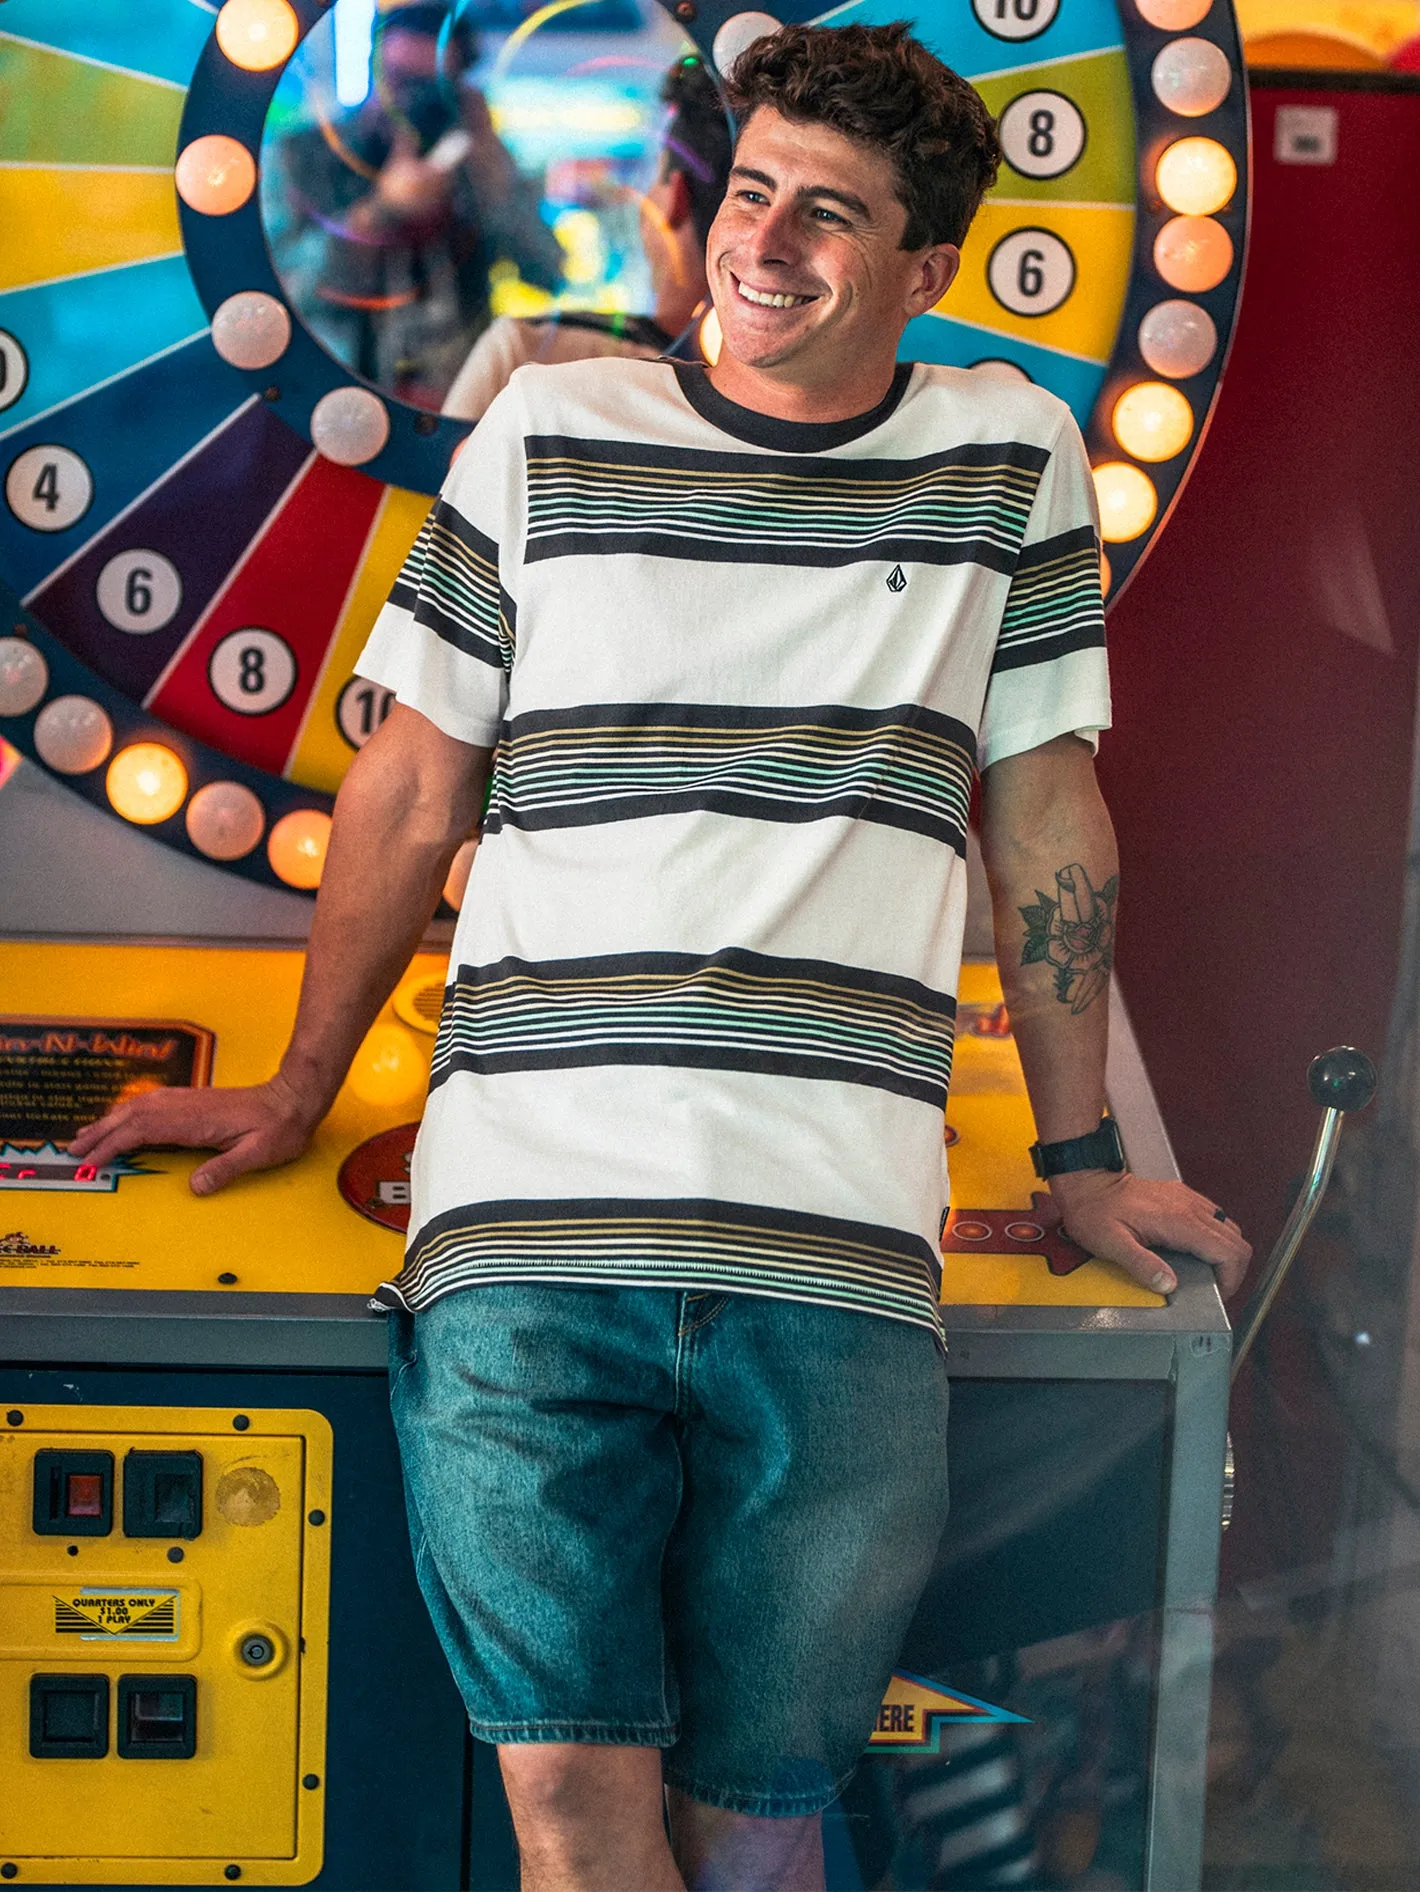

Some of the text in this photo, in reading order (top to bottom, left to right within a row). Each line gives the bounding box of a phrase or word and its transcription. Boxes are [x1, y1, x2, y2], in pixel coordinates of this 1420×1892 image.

[1027, 109, 1056, 158] 8
[1016, 249, 1045, 297] 6
[31, 463, 60, 513] 4
[124, 567, 153, 616] 6
[239, 647, 266, 695] 8
[72, 1598, 155, 1608] QUARTERS ONLY
[98, 1615, 131, 1624] 1 PLAY
[100, 1606, 128, 1616] $1.00
[874, 1704, 915, 1732] ERE
